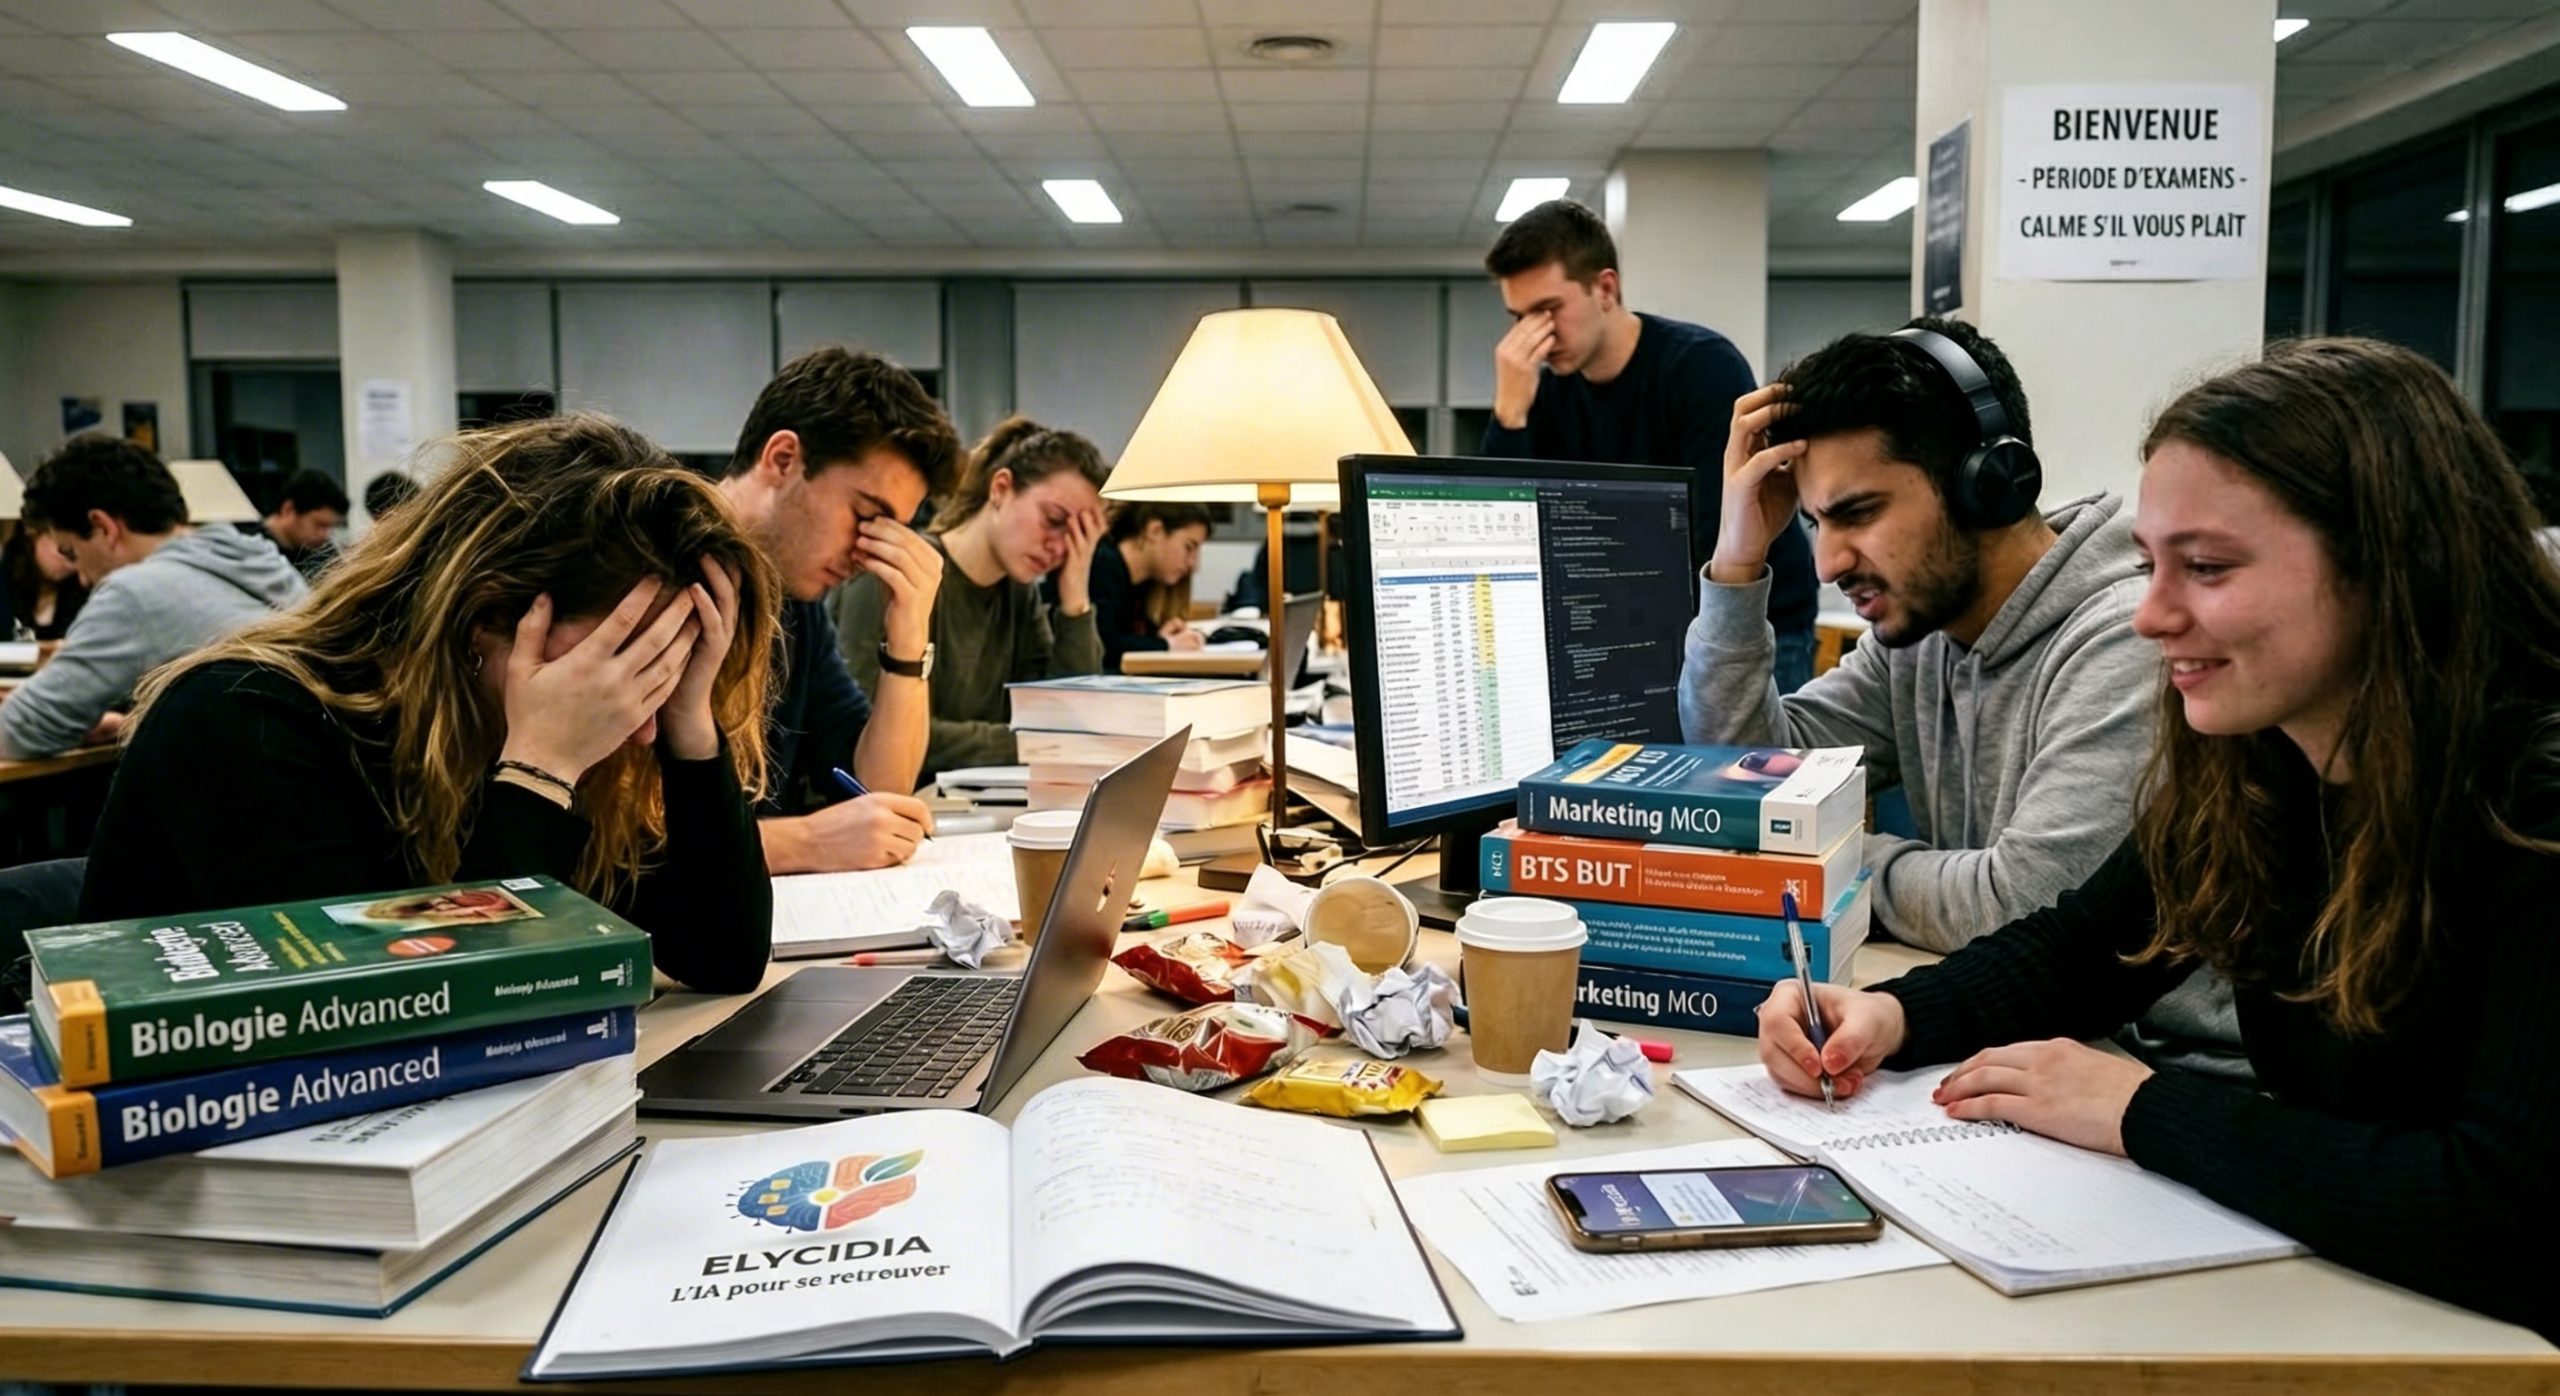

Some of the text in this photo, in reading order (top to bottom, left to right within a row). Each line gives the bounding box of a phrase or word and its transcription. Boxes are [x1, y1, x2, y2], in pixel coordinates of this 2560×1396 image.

[2053, 108, 2219, 141] BIENVENUE
[2032, 166, 2117, 189] PÉRIODE
[2123, 166, 2236, 189] D'EXAMENS
[2020, 211, 2247, 239] CALME S'IL VOUS PLAÎT
[1549, 795, 1721, 836] Marketing MCO
[1520, 855, 1569, 883] BTS
[1576, 858, 1633, 888] BUT
[1577, 979, 1718, 1017] rketing MCO
[131, 1009, 288, 1058] Biologie
[298, 982, 451, 1034] Advanced
[122, 1081, 281, 1143] Biologie
[289, 1047, 441, 1108] Advanced
[702, 1236, 932, 1276] ELYCIDIA
[671, 1264, 951, 1302] L'IA pour se retrouver
